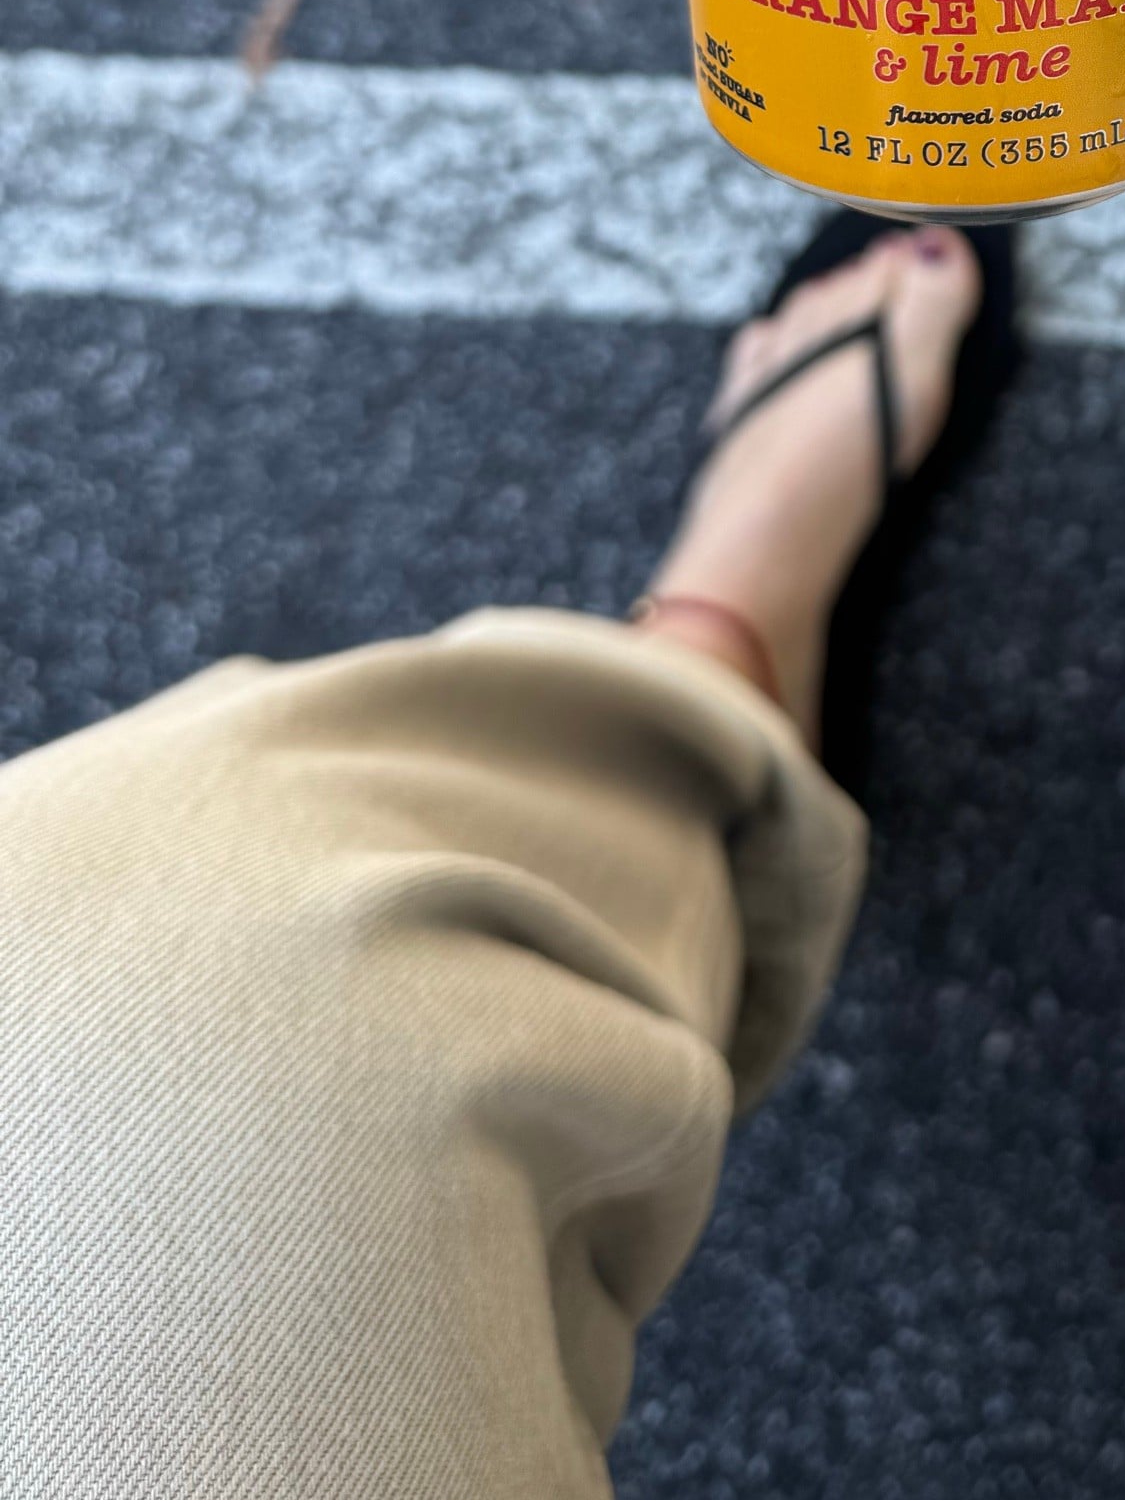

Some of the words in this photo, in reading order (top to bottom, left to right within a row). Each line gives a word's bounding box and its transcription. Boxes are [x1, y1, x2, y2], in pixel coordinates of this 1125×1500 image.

[874, 46, 907, 84] &
[921, 41, 1072, 88] lime
[719, 69, 767, 111] SUGAR
[885, 104, 994, 126] flavored
[999, 101, 1062, 123] soda
[816, 125, 852, 157] 12
[865, 136, 911, 166] FL
[922, 141, 968, 167] OZ
[980, 136, 1069, 168] (355
